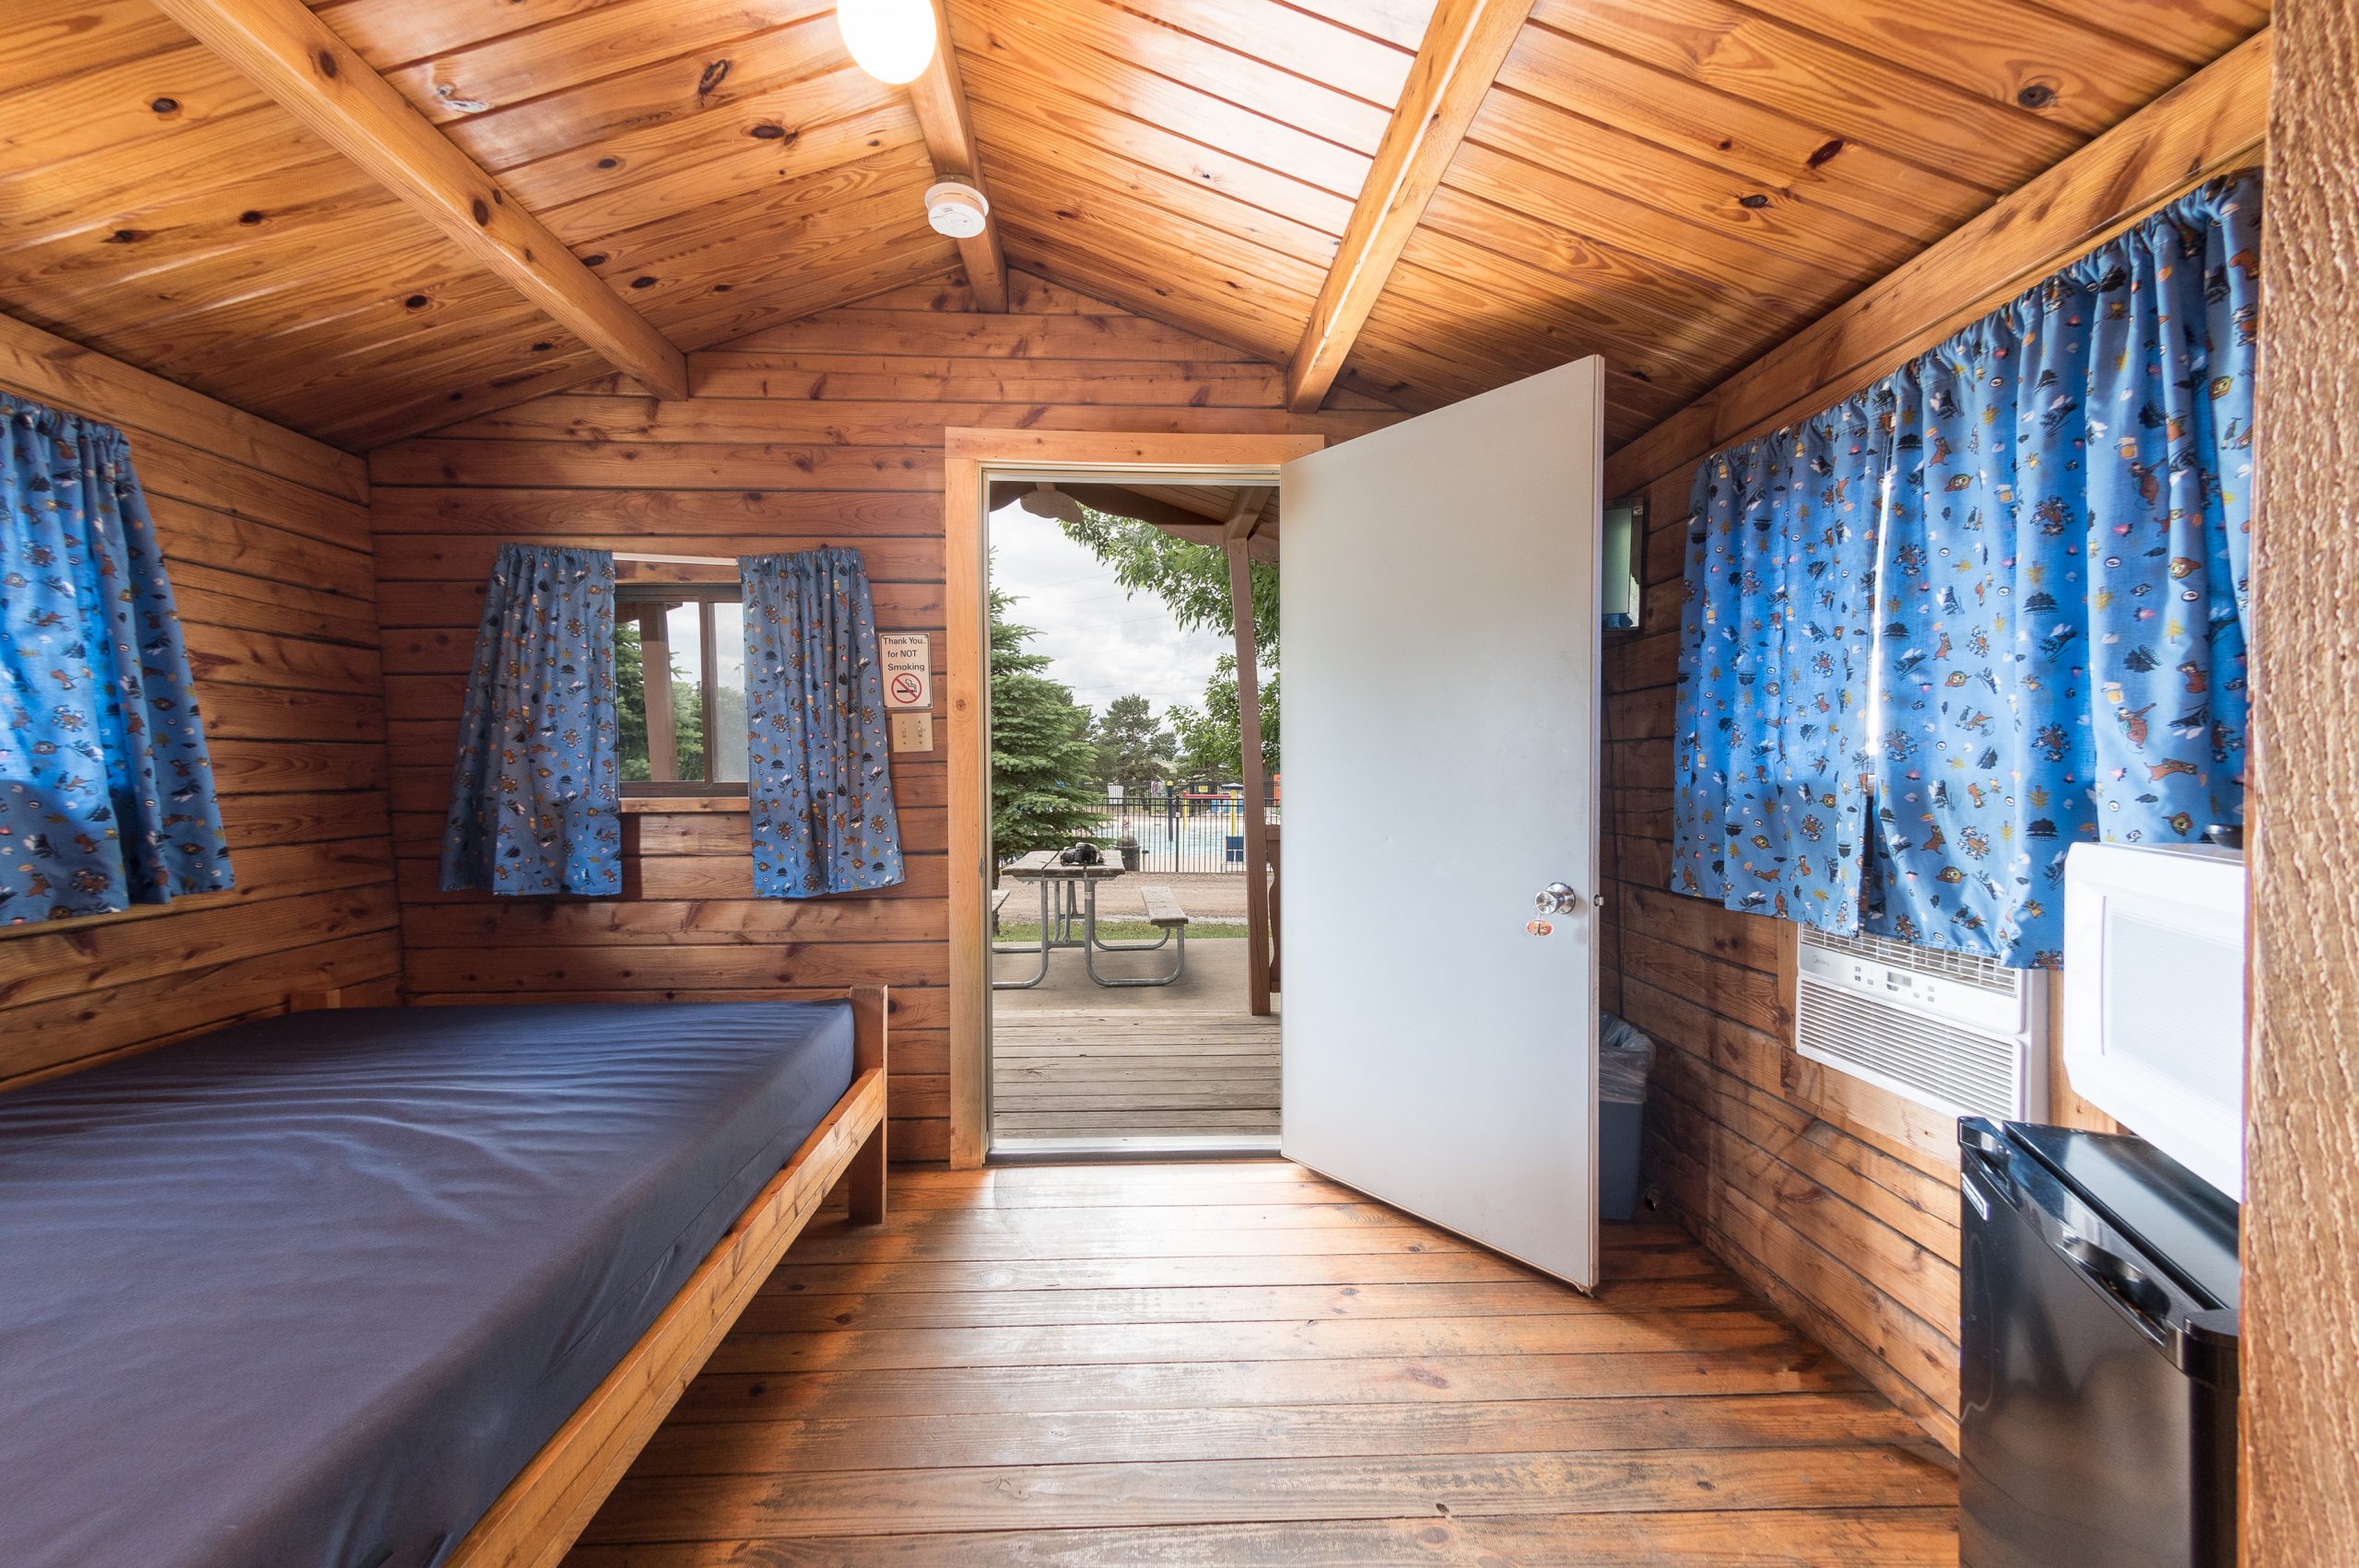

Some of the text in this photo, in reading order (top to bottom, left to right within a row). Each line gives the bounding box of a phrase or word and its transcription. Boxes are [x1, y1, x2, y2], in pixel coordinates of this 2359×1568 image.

[883, 637, 908, 645] Thank
[899, 649, 918, 658] NOT
[887, 663, 925, 673] Smoking
